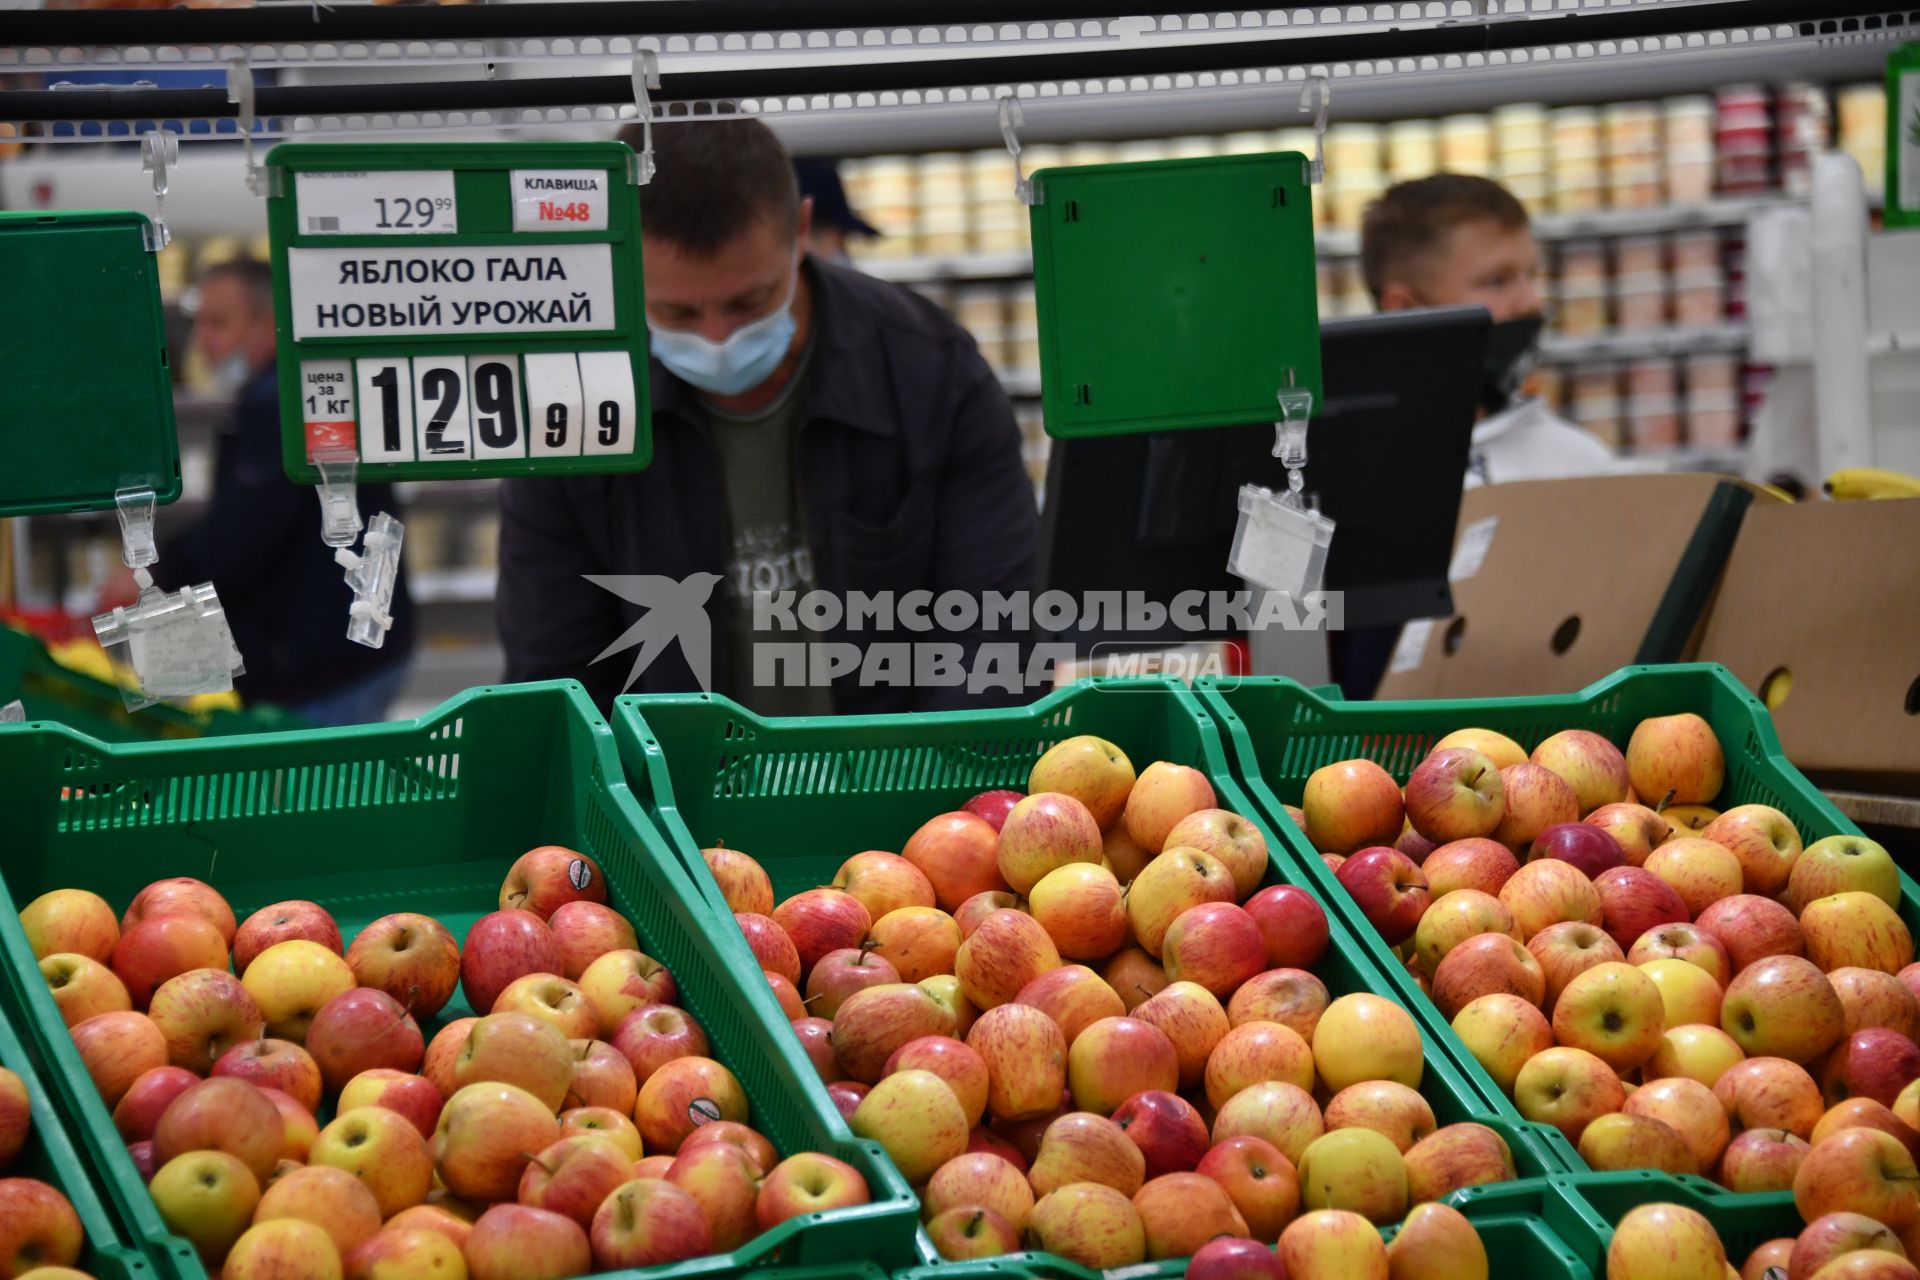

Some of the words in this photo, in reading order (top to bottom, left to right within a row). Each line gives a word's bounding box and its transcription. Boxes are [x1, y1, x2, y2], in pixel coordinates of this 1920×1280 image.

[524, 177, 598, 191] КЛАВИША
[539, 201, 590, 222] №48
[338, 258, 475, 285] ЯБЛОКО
[486, 257, 567, 281] ГАЛА
[316, 295, 442, 328] НОВЫЙ
[451, 292, 592, 325] УРОЖАЙ
[307, 372, 344, 384] цена
[318, 385, 335, 395] за
[306, 395, 316, 415] 1
[327, 399, 350, 414] кг
